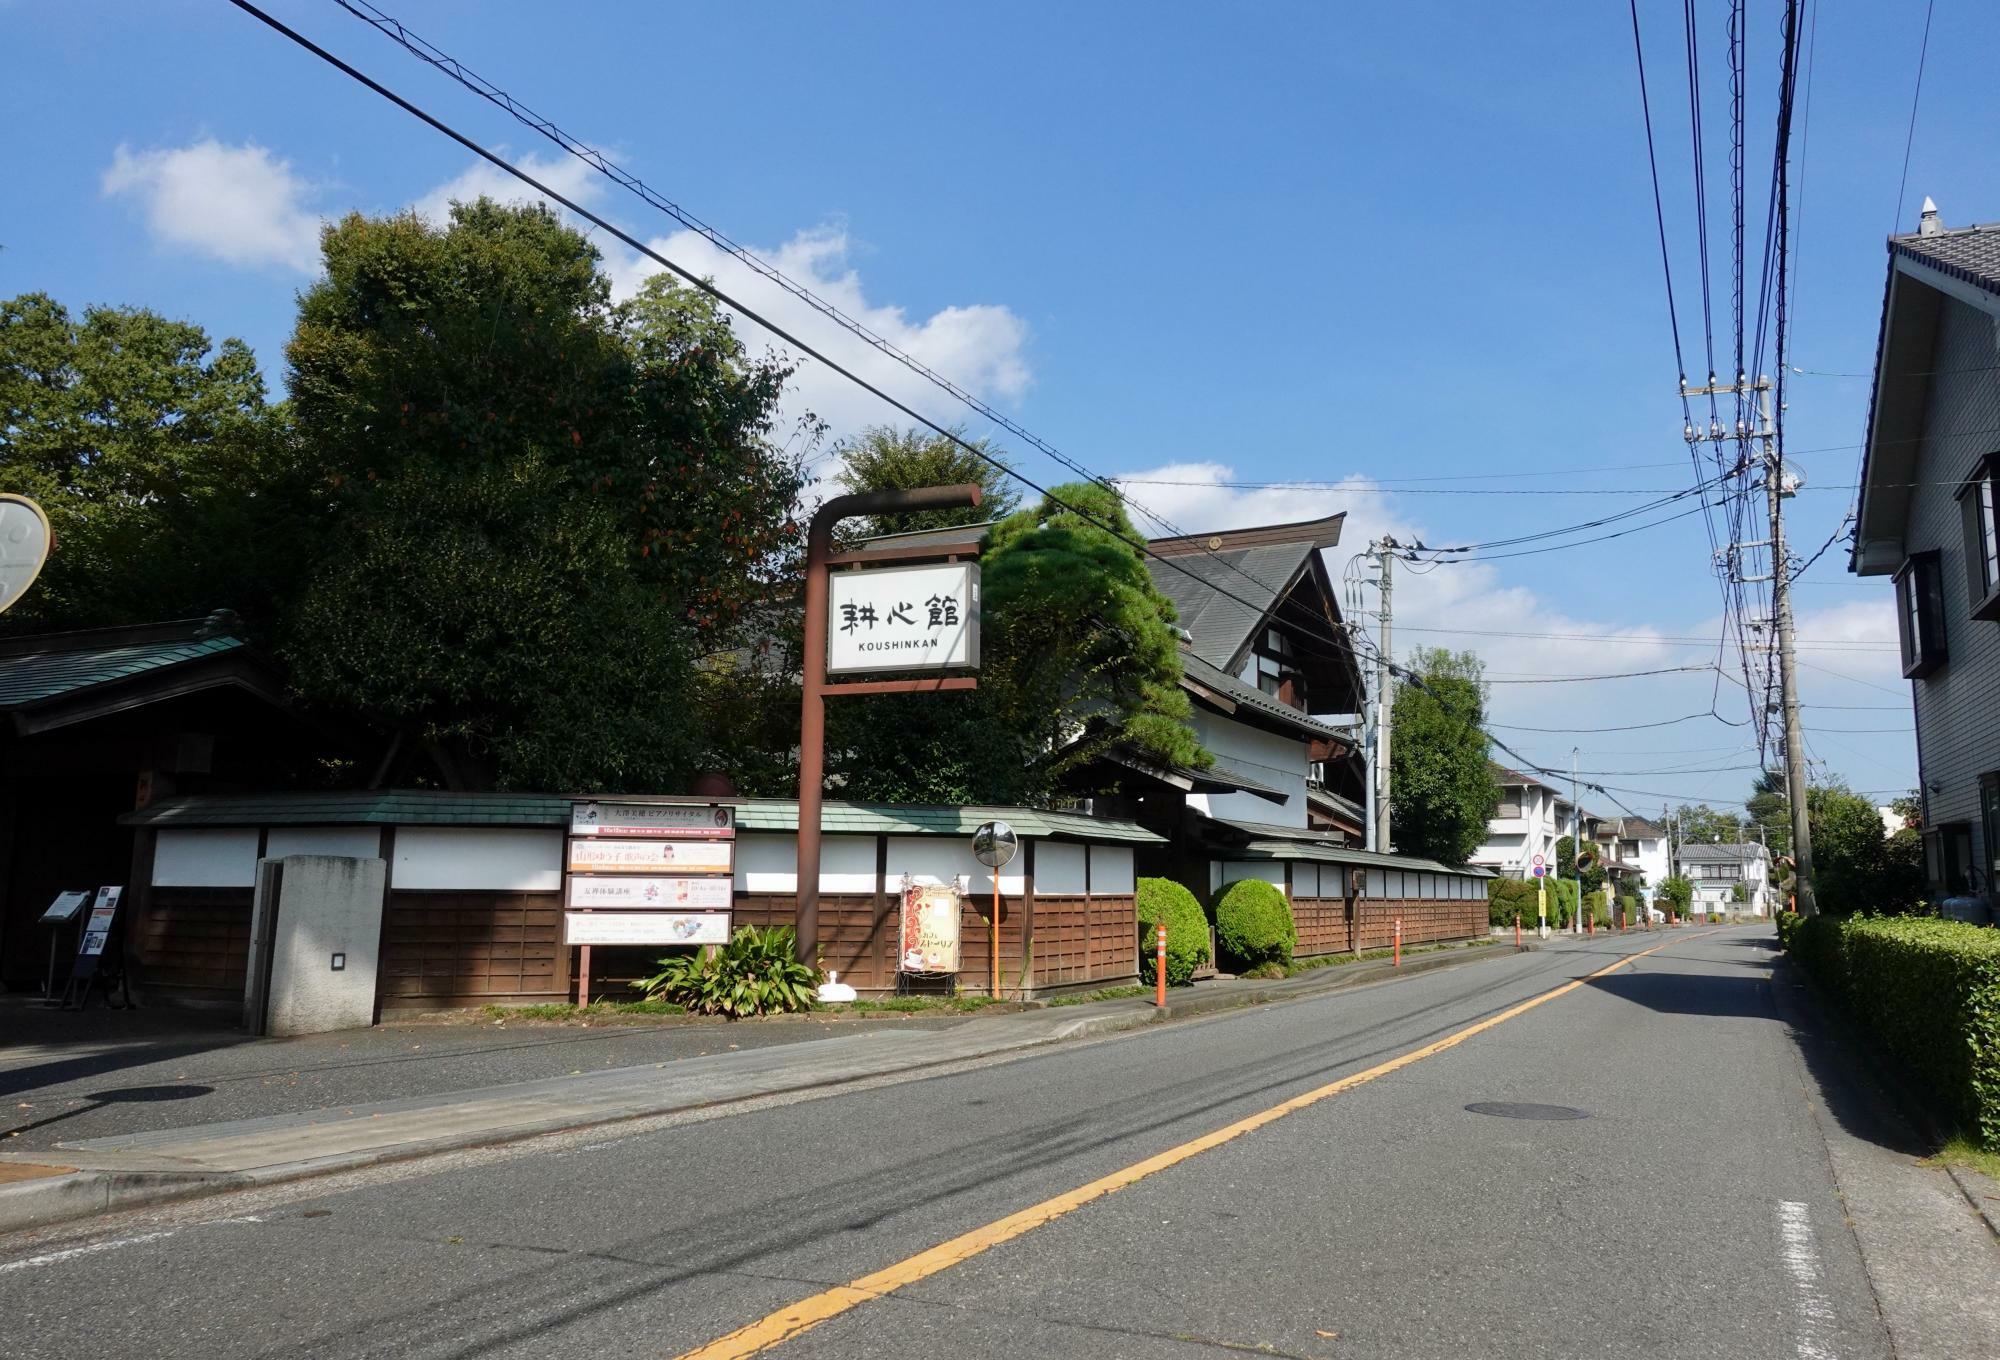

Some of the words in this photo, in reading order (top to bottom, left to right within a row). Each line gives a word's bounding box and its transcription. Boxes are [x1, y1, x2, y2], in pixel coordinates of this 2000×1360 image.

[839, 593, 959, 636] 耕心館
[858, 638, 938, 652] KOUSHINKAN
